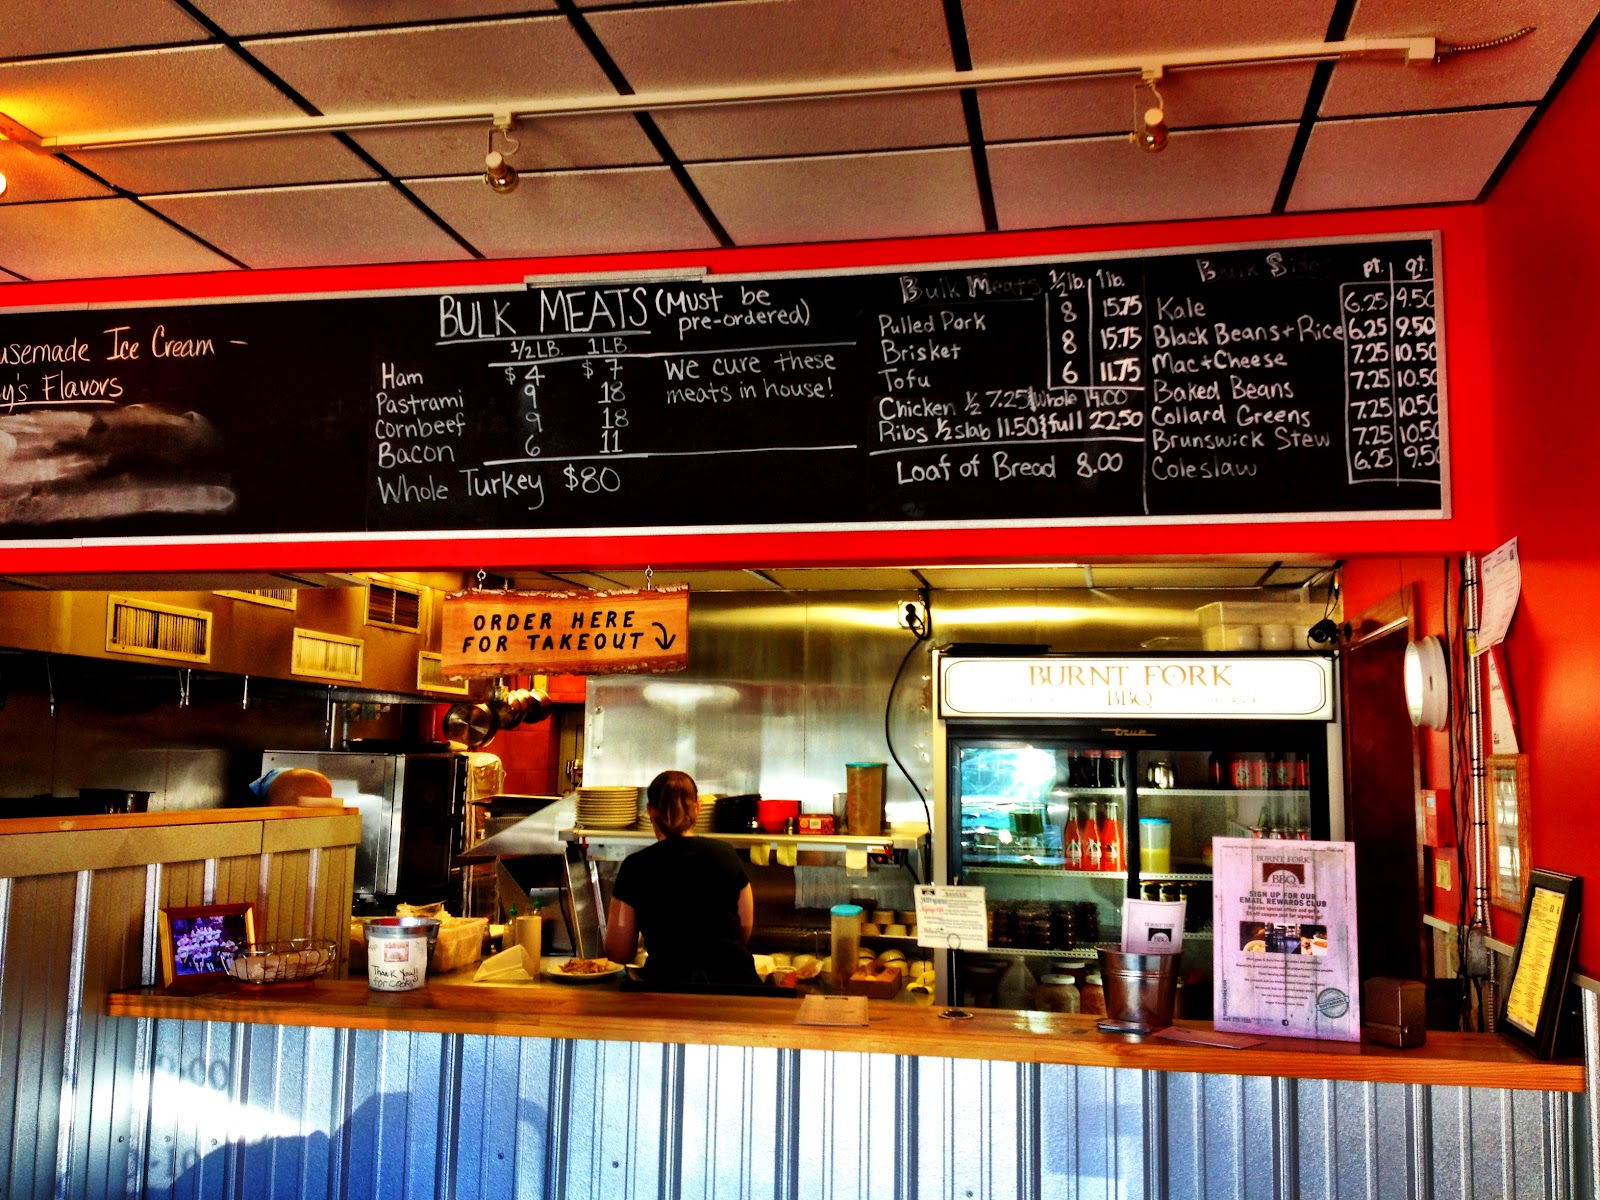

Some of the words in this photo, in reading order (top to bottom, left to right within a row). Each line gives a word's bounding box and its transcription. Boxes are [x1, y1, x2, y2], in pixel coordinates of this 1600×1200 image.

[899, 275, 961, 305] Bulk
[966, 272, 1043, 298] Meats
[1157, 297, 1207, 321] Kale
[1343, 290, 1390, 315] 6.25
[1396, 286, 1435, 309] 9.50
[438, 294, 518, 339] BULK
[539, 287, 648, 334] MEATS
[655, 287, 724, 318] (Must
[740, 284, 772, 307] be
[678, 297, 811, 341] pre-ordered)
[878, 313, 935, 337] Pulled
[939, 309, 987, 332] Pork
[1060, 300, 1077, 323] 8
[103, 324, 140, 362] Ice
[151, 324, 216, 358] Cream
[881, 338, 962, 365] Brisket
[1061, 328, 1078, 354] 8
[1100, 325, 1143, 350] 15.75
[1153, 325, 1209, 349] Black
[1348, 316, 1389, 341] 6.25
[1394, 315, 1437, 339] 9.50
[664, 359, 701, 382] We
[712, 355, 762, 376] cure
[773, 350, 838, 373] these
[1350, 341, 1391, 366] 7.25
[1394, 341, 1438, 363] 10.50
[41, 370, 124, 400] Flavors
[381, 361, 424, 390] Ham
[666, 382, 733, 405] meats
[739, 380, 757, 400] in
[762, 376, 836, 400] house!
[877, 368, 932, 392] Tofu
[1061, 360, 1079, 384] 6
[1099, 357, 1142, 382] 11.75
[1153, 379, 1221, 404] Baked
[1229, 374, 1295, 402] Beans
[1349, 367, 1391, 391] 7.25
[376, 388, 465, 416] Pastrami
[523, 383, 538, 409] 9
[597, 380, 627, 404] 18
[878, 396, 957, 421] Chicken
[985, 389, 1030, 409] 7.25
[1151, 405, 1227, 427] Collard
[1236, 403, 1312, 429] Greens
[1349, 396, 1393, 421] 7.25
[1397, 392, 1440, 419] 10.50
[524, 411, 543, 433] 9
[600, 407, 630, 430] 18
[878, 420, 930, 443] Ribs
[996, 416, 1039, 439] 11.50
[1048, 410, 1084, 434] full
[1088, 409, 1145, 433] 22.50
[377, 440, 456, 470] Bacon
[524, 434, 541, 457] 6
[598, 429, 624, 454] 11
[1151, 428, 1266, 454] Brunswick
[1273, 425, 1332, 451] Stew
[1351, 424, 1394, 446] 7.25
[897, 453, 952, 485] Loaf
[959, 453, 981, 478] of
[991, 451, 1057, 482] Bread
[1075, 452, 1124, 479] 8.00
[1151, 455, 1259, 481] Coleslaw
[1353, 446, 1394, 471] 6.25
[377, 473, 450, 505] Whole
[458, 467, 545, 511] Turkey
[562, 463, 622, 494] $80
[473, 612, 552, 632] ORDER
[571, 610, 636, 629] HERE
[462, 634, 508, 654] FOR
[526, 632, 645, 651] TAKEOUT
[1029, 665, 1129, 687] BURNT
[1144, 665, 1233, 687] FORK
[1106, 690, 1153, 709] BBQ
[1256, 854, 1284, 863] BURNT
[1287, 855, 1310, 864] FORK
[1272, 874, 1296, 884] BBQ
[1239, 897, 1264, 905] EMAIL
[1266, 898, 1304, 907] REWARDS
[1306, 900, 1327, 908] CLUB
[1249, 890, 1268, 898] SIGN
[1270, 891, 1281, 899] UP
[1283, 892, 1299, 900] FOR
[1300, 892, 1317, 901] OUR
[371, 965, 398, 979] Thank
[373, 976, 388, 988] for
